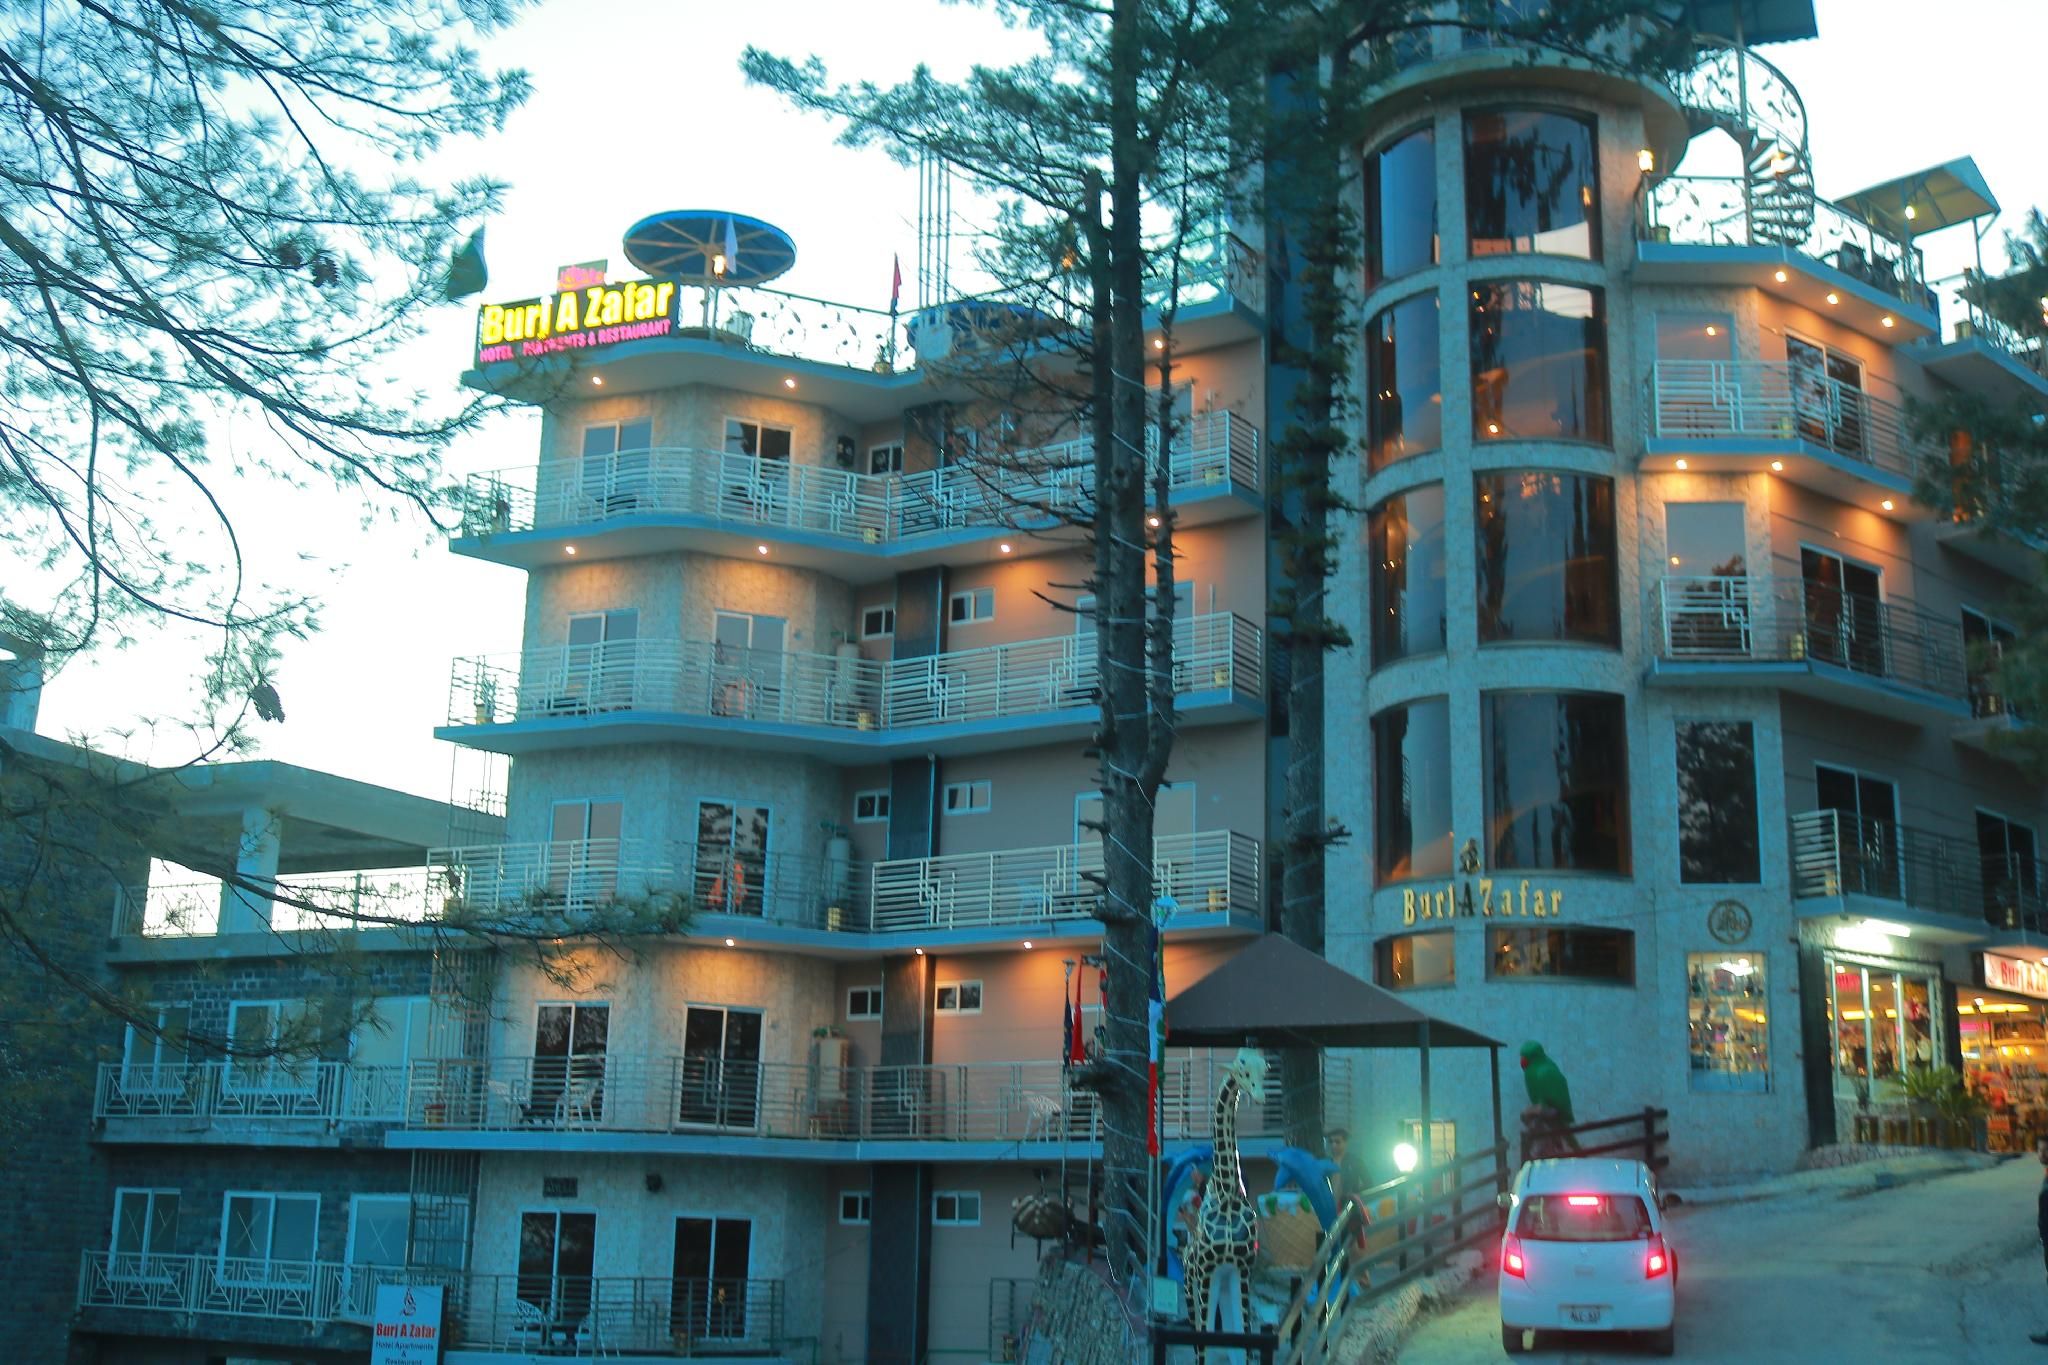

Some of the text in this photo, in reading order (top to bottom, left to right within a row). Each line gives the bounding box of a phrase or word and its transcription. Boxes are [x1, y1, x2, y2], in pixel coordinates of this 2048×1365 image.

[482, 281, 674, 345] Burj A Zafar
[480, 345, 514, 362] HOTEL
[598, 319, 671, 344] RESTAURANT
[1458, 881, 1475, 917] A
[1479, 878, 1563, 918] Zafar
[376, 1322, 436, 1339] Burj A Zafar
